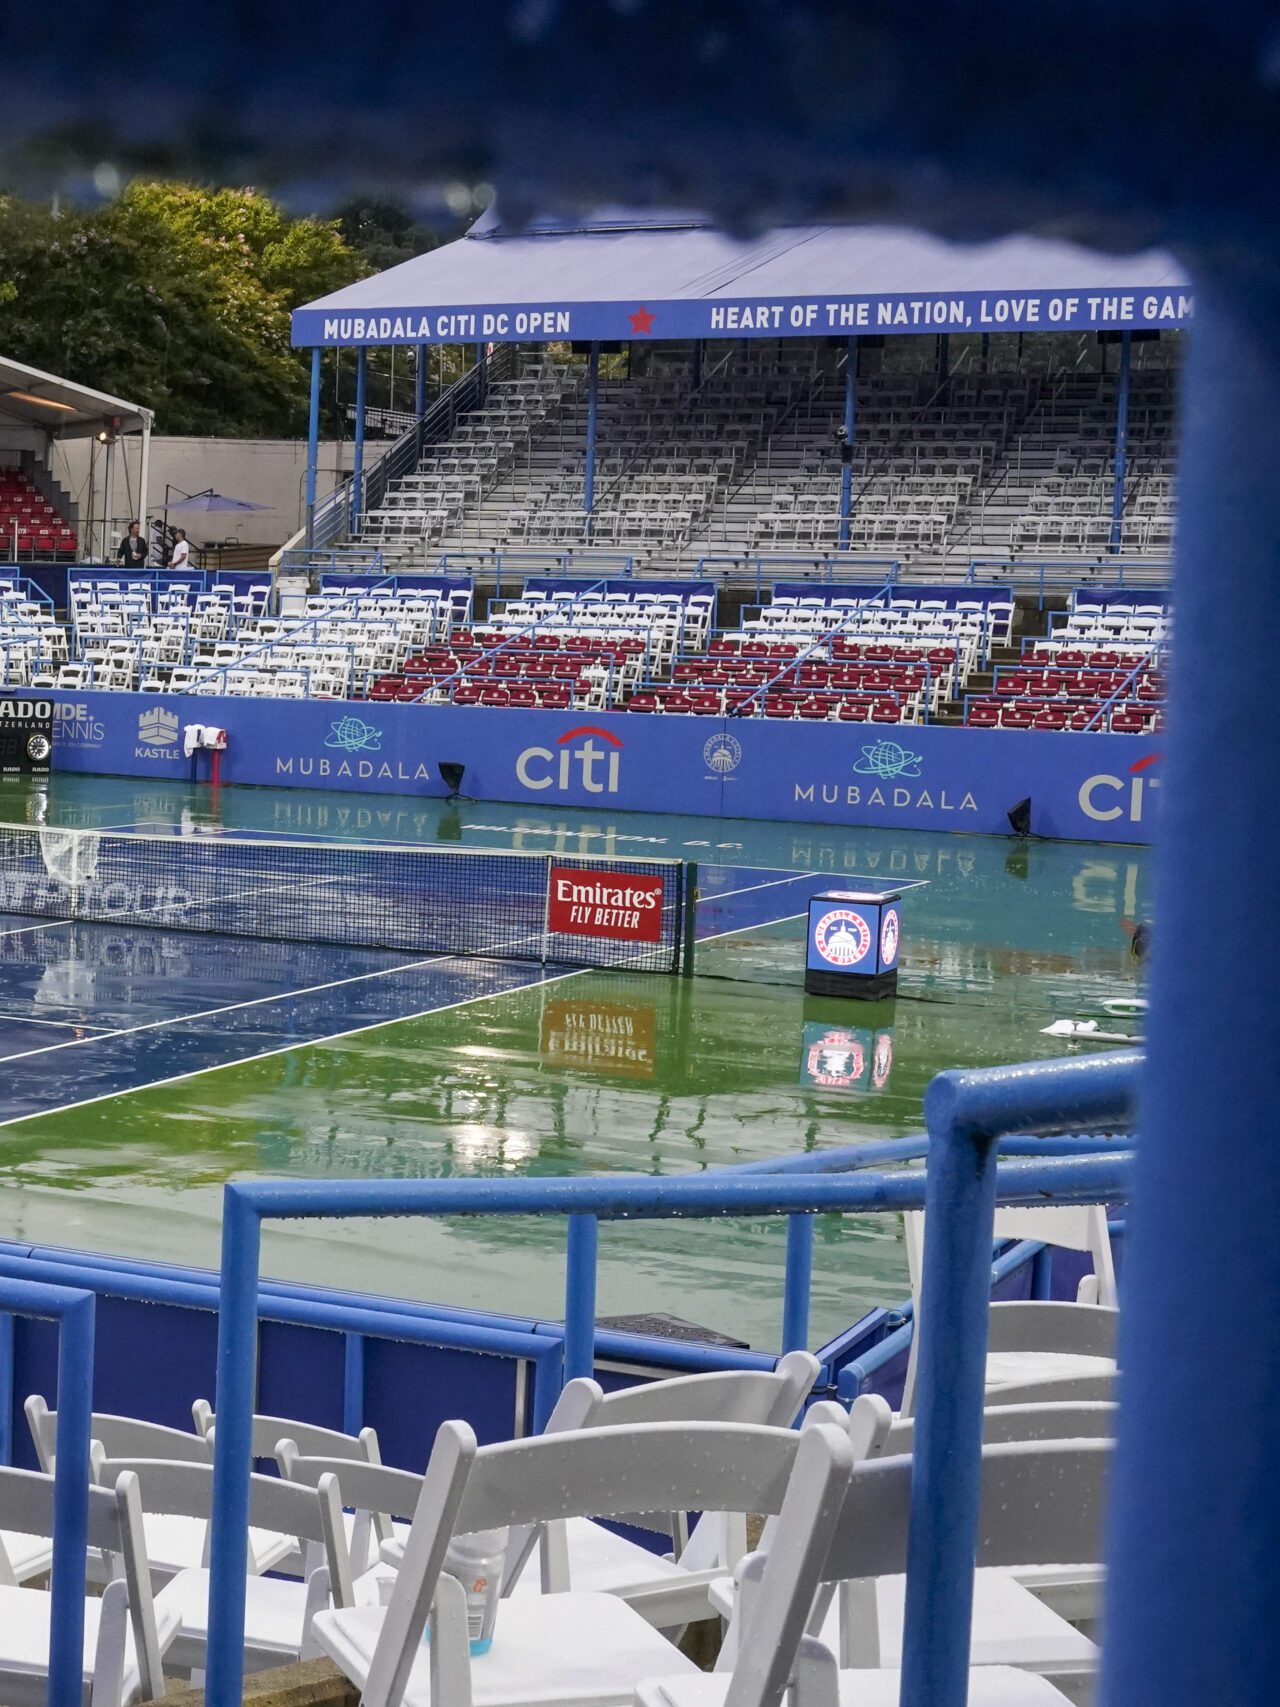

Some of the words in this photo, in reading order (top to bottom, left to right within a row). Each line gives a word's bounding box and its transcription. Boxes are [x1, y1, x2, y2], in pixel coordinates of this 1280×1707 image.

[324, 316, 431, 339] MUBADALA
[437, 314, 475, 336] CITI
[483, 313, 509, 335] DC
[516, 311, 570, 333] OPEN
[711, 306, 784, 329] HEART
[790, 304, 818, 327] OF
[826, 303, 869, 326] THE
[877, 301, 972, 327] NATION,
[980, 299, 1040, 323] LOVE
[1048, 298, 1079, 321] OF
[1087, 296, 1135, 320] THE
[1143, 295, 1195, 320] GAM
[52, 720, 105, 741] ENNIS
[135, 747, 180, 760] KASTLE
[515, 726, 624, 793] citi
[276, 757, 430, 781] MUBADALA
[795, 783, 978, 812] MUBADALA
[1079, 753, 1160, 821] ci
[570, 905, 593, 926] FLY
[594, 908, 640, 929] BETTER
